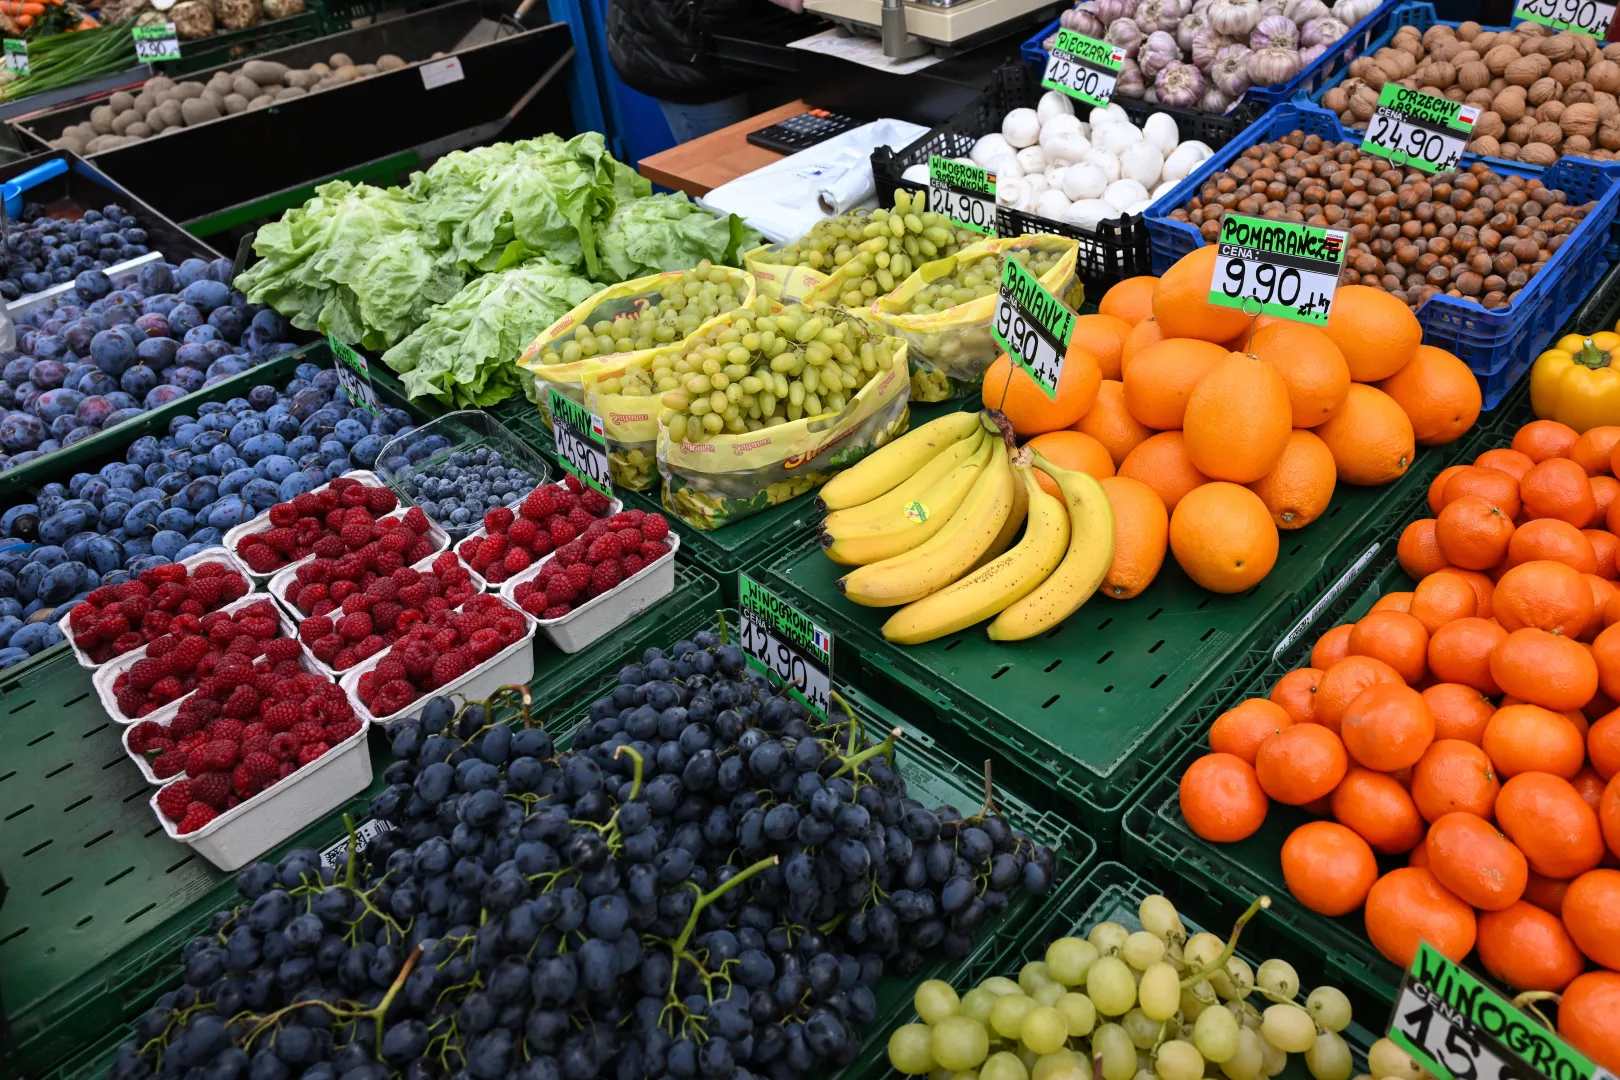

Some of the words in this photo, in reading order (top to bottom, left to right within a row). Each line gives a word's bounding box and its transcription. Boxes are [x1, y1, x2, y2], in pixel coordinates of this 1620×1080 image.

[1055, 50, 1075, 62] CENA:
[1397, 89, 1460, 116] ORZECHY
[1378, 107, 1408, 122] CENA:
[931, 179, 952, 191] CENA:
[1221, 245, 1260, 261] CENA:
[1007, 261, 1063, 334] BANANY
[743, 614, 772, 634] CENA:
[1413, 982, 1479, 1037] CENA:
